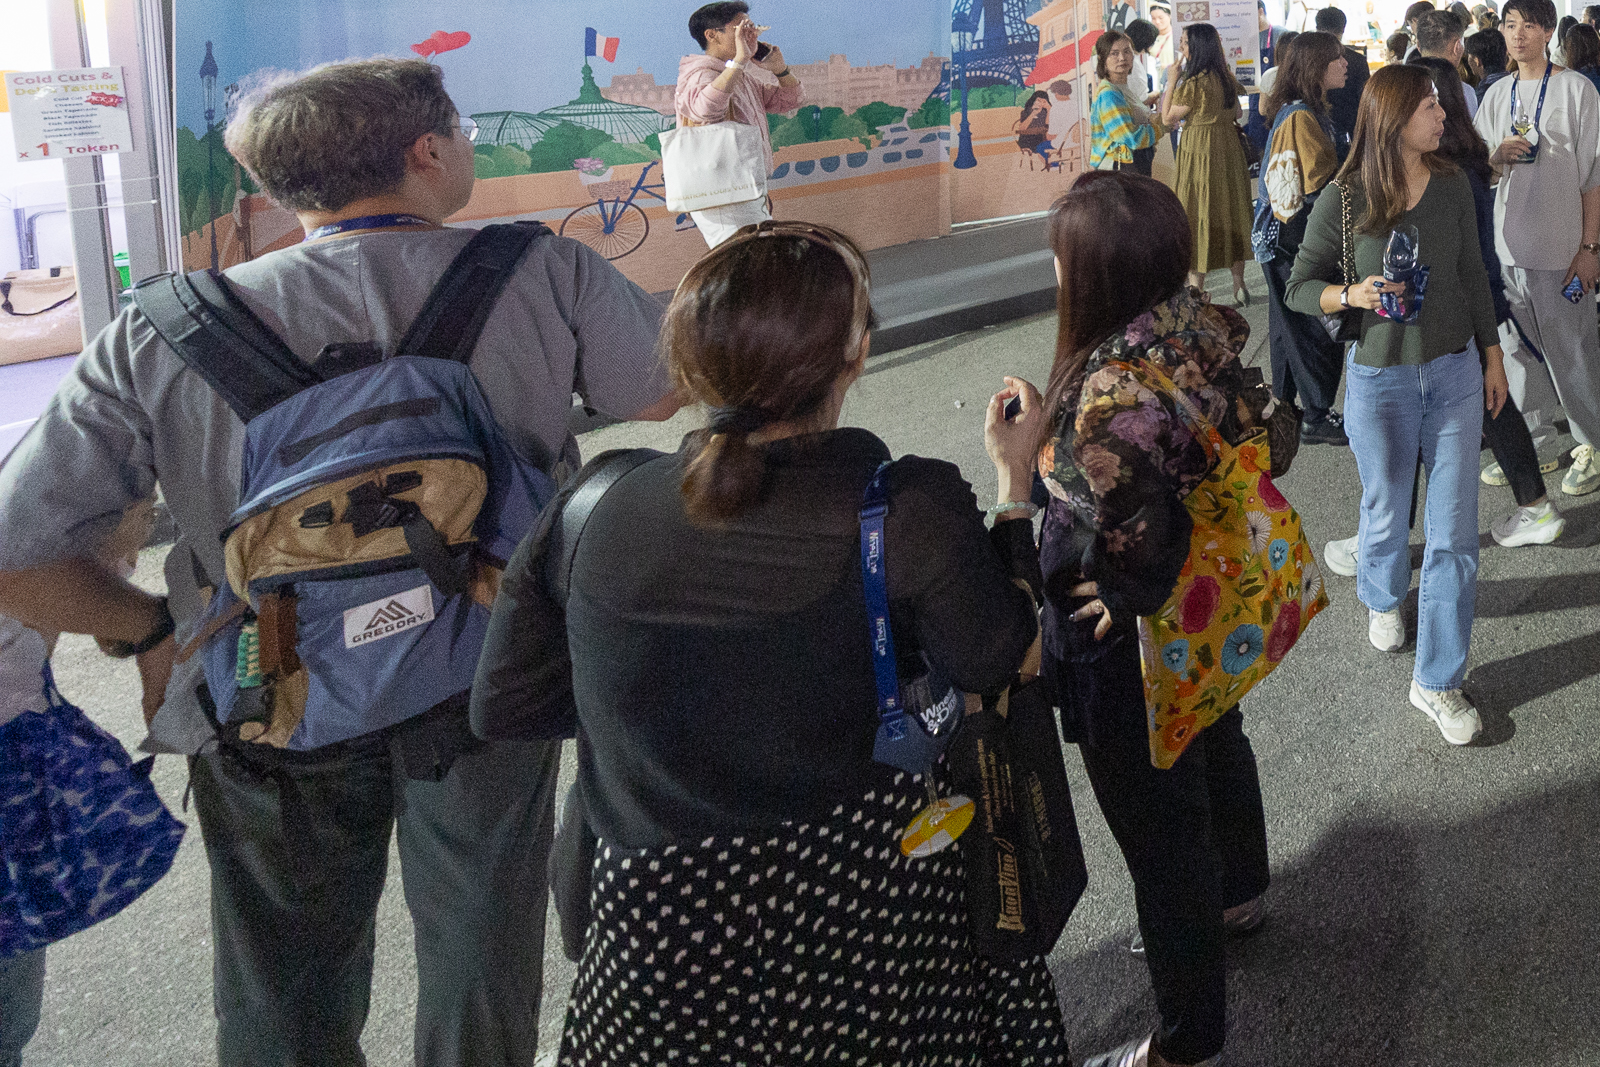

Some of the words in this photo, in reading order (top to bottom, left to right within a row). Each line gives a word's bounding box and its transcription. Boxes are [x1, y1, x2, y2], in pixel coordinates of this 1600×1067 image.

[1215, 9, 1220, 18] 3
[13, 75, 52, 85] Cold
[58, 73, 96, 83] Cuts
[101, 72, 113, 80] &
[63, 83, 119, 93] Tasting
[19, 151, 29, 159] x
[36, 142, 49, 157] 1
[65, 143, 120, 154] Token
[352, 612, 427, 643] GREGORY
